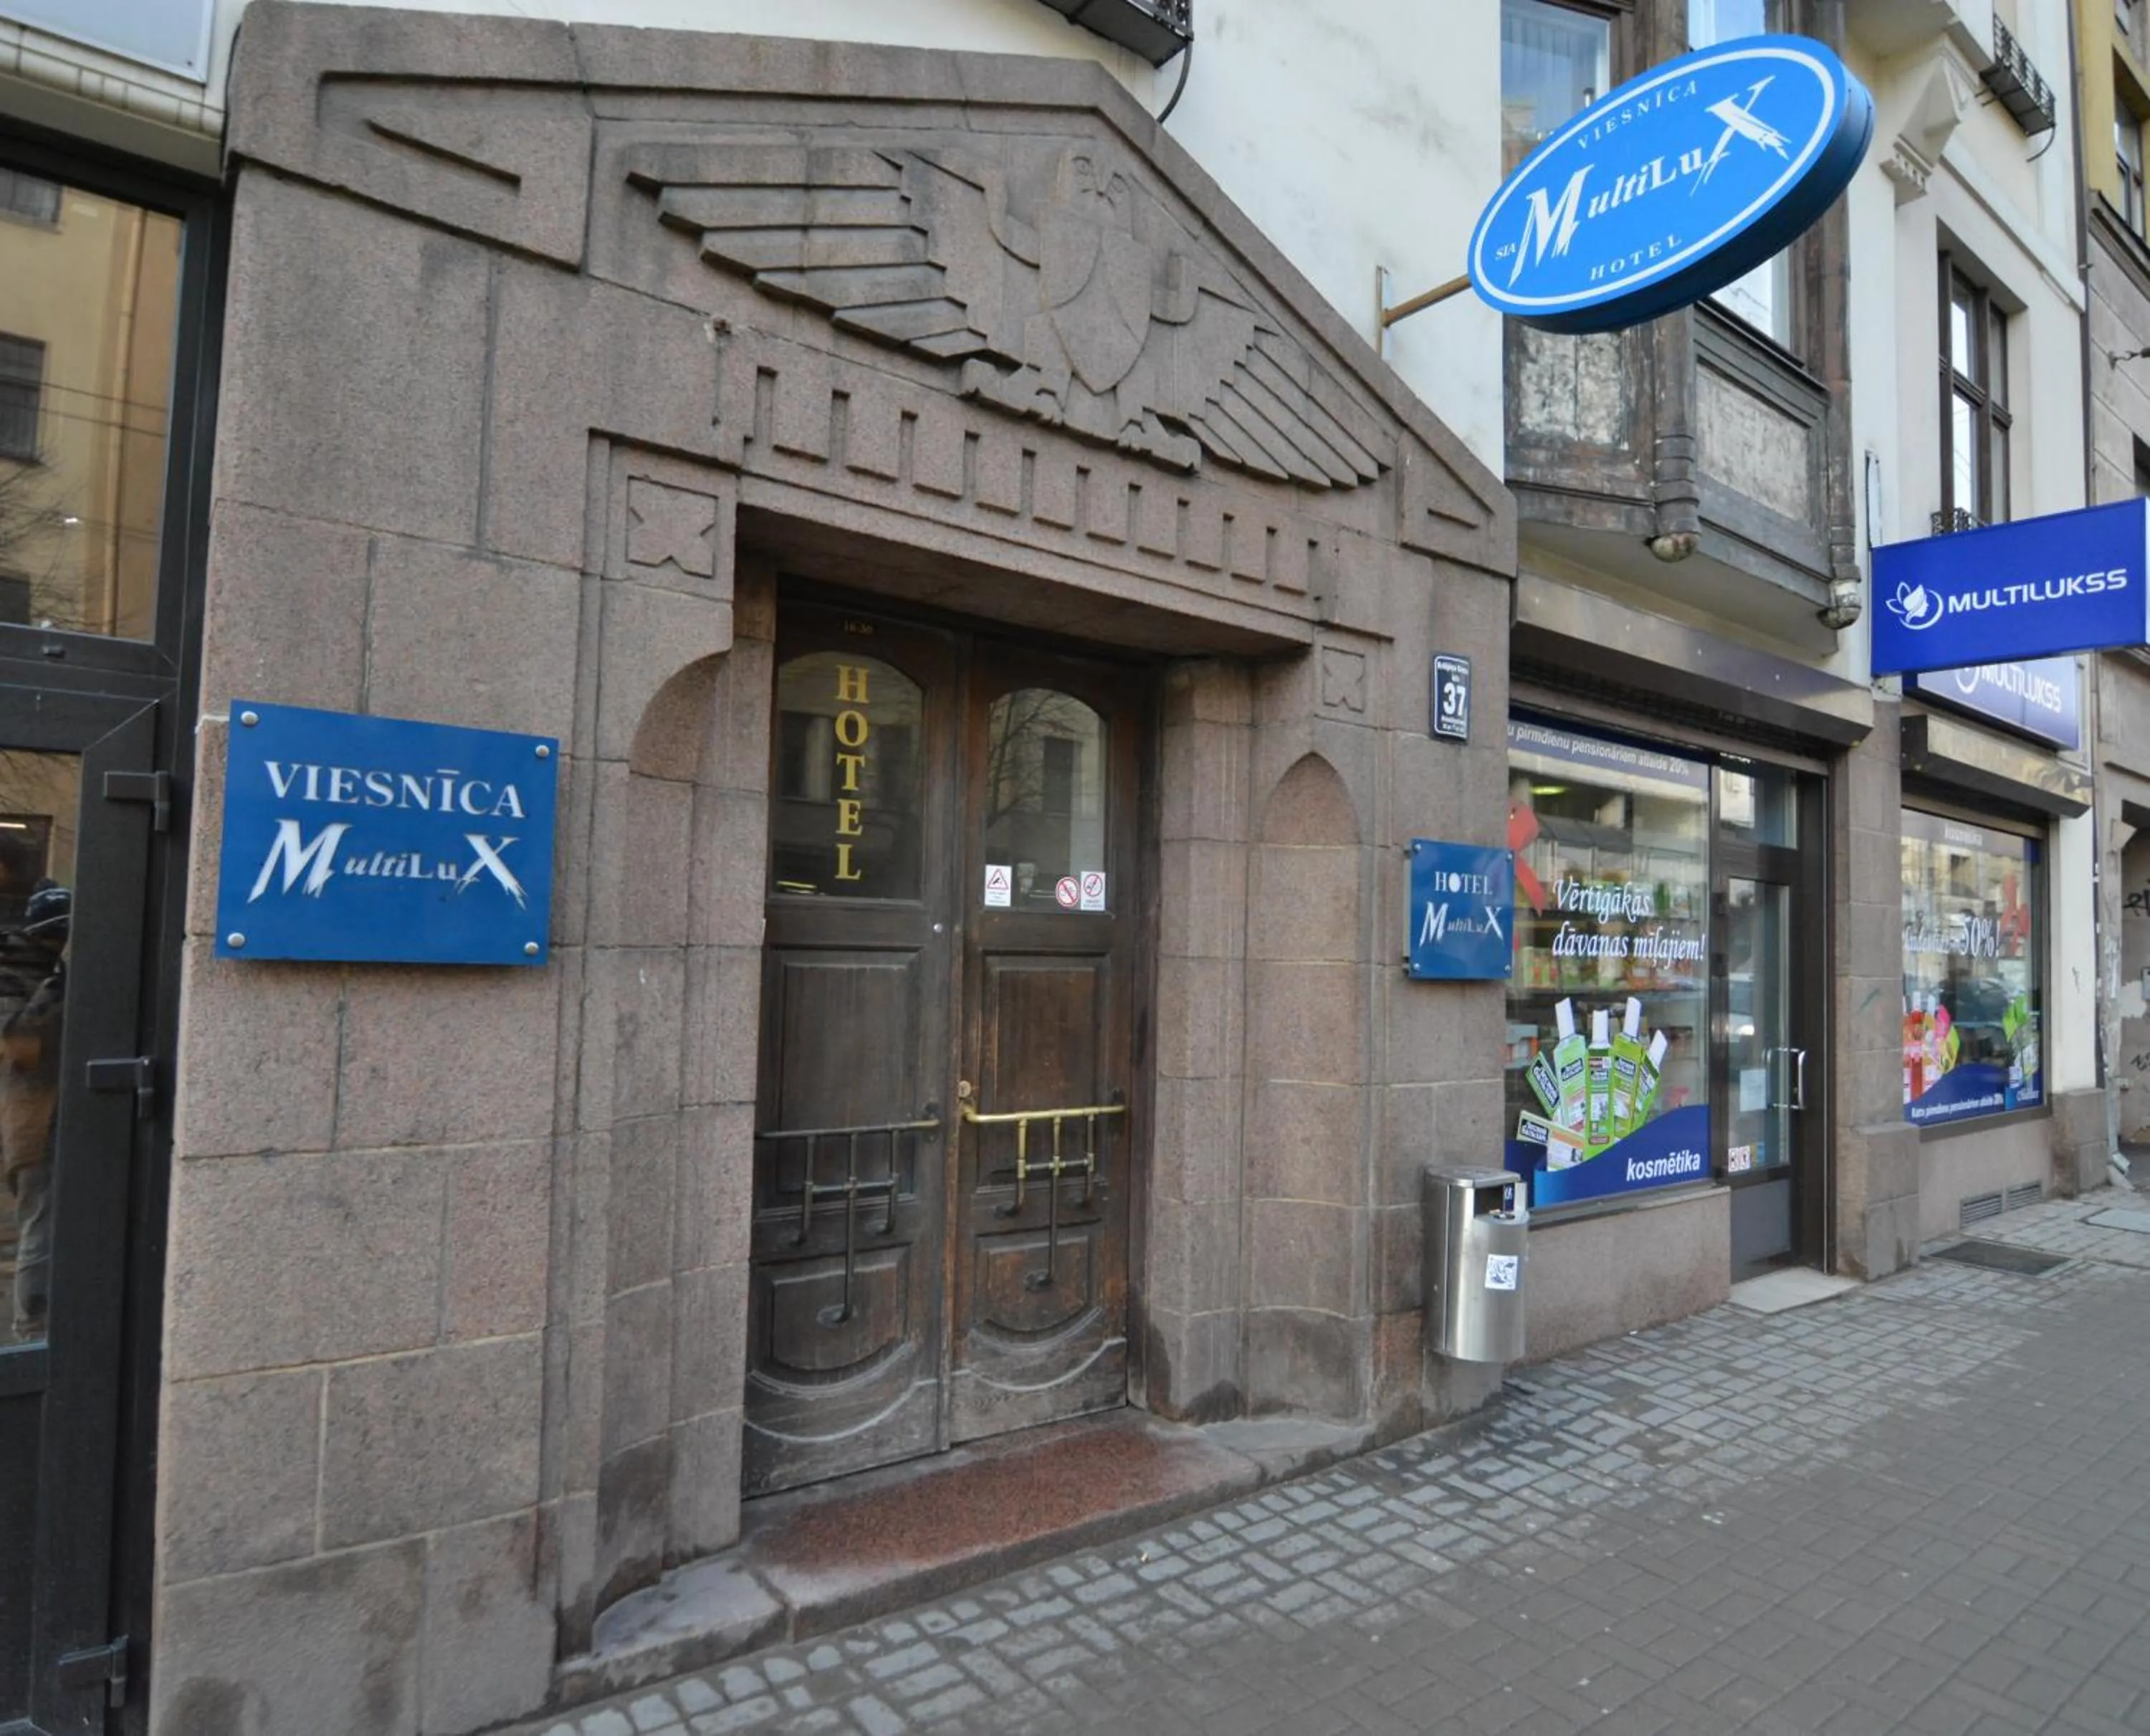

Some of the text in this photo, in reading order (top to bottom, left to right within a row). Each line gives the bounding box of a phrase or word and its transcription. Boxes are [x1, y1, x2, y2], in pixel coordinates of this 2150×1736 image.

[1590, 234, 1682, 281] HOTEL
[1949, 568, 2127, 614] MULTILUKSS
[1443, 682, 1466, 716] 37
[264, 760, 525, 819] VIESNĪCA
[835, 664, 869, 880] HOTEL
[1434, 871, 1494, 895] HOTEL
[1552, 875, 1650, 923] Vērtīgākās
[1552, 920, 1705, 970] dāvanas mīļajiem!
[1626, 1150, 1701, 1182] kosmētika
